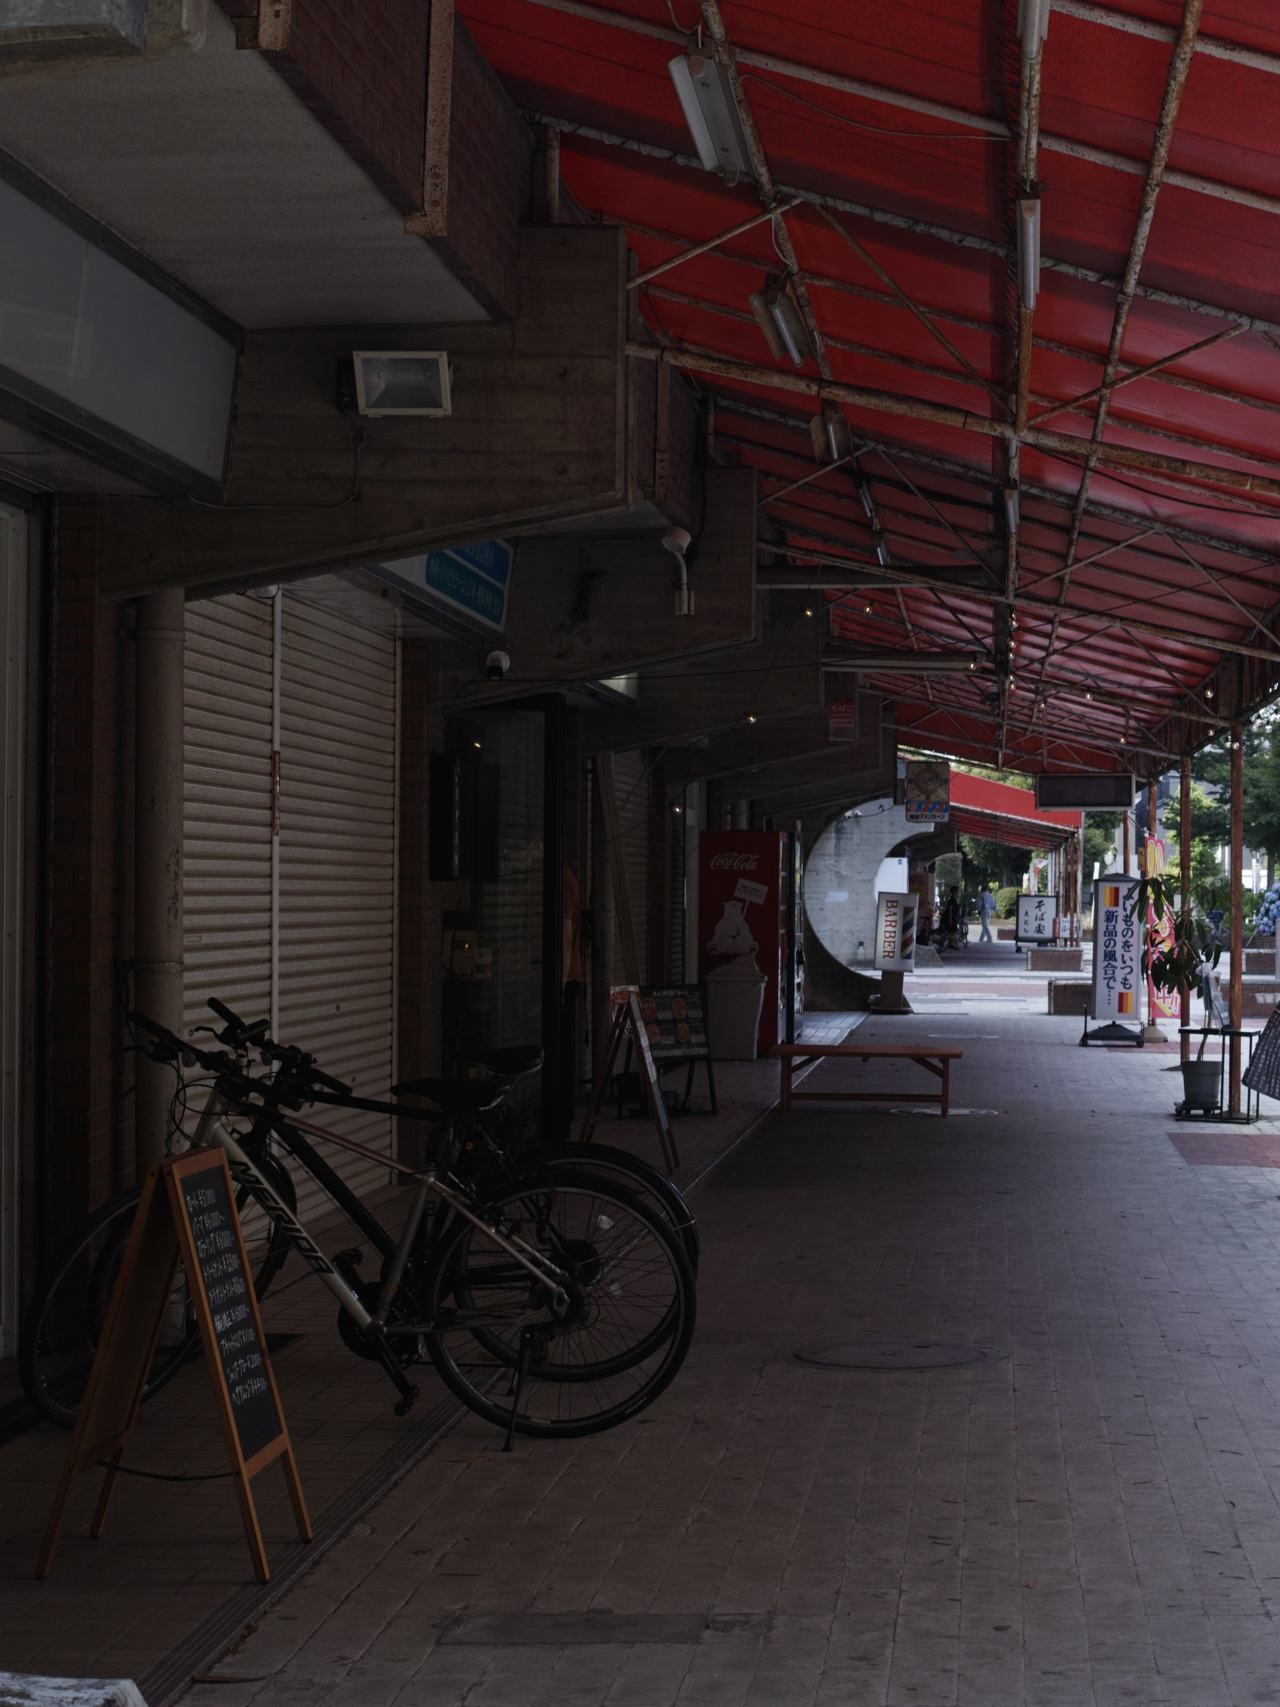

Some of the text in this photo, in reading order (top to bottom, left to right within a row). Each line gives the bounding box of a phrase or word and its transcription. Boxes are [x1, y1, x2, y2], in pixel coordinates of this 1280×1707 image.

[710, 853, 761, 871] Coca-Cola
[882, 899, 899, 960] BARBER
[228, 1159, 336, 1275] MERIDA
